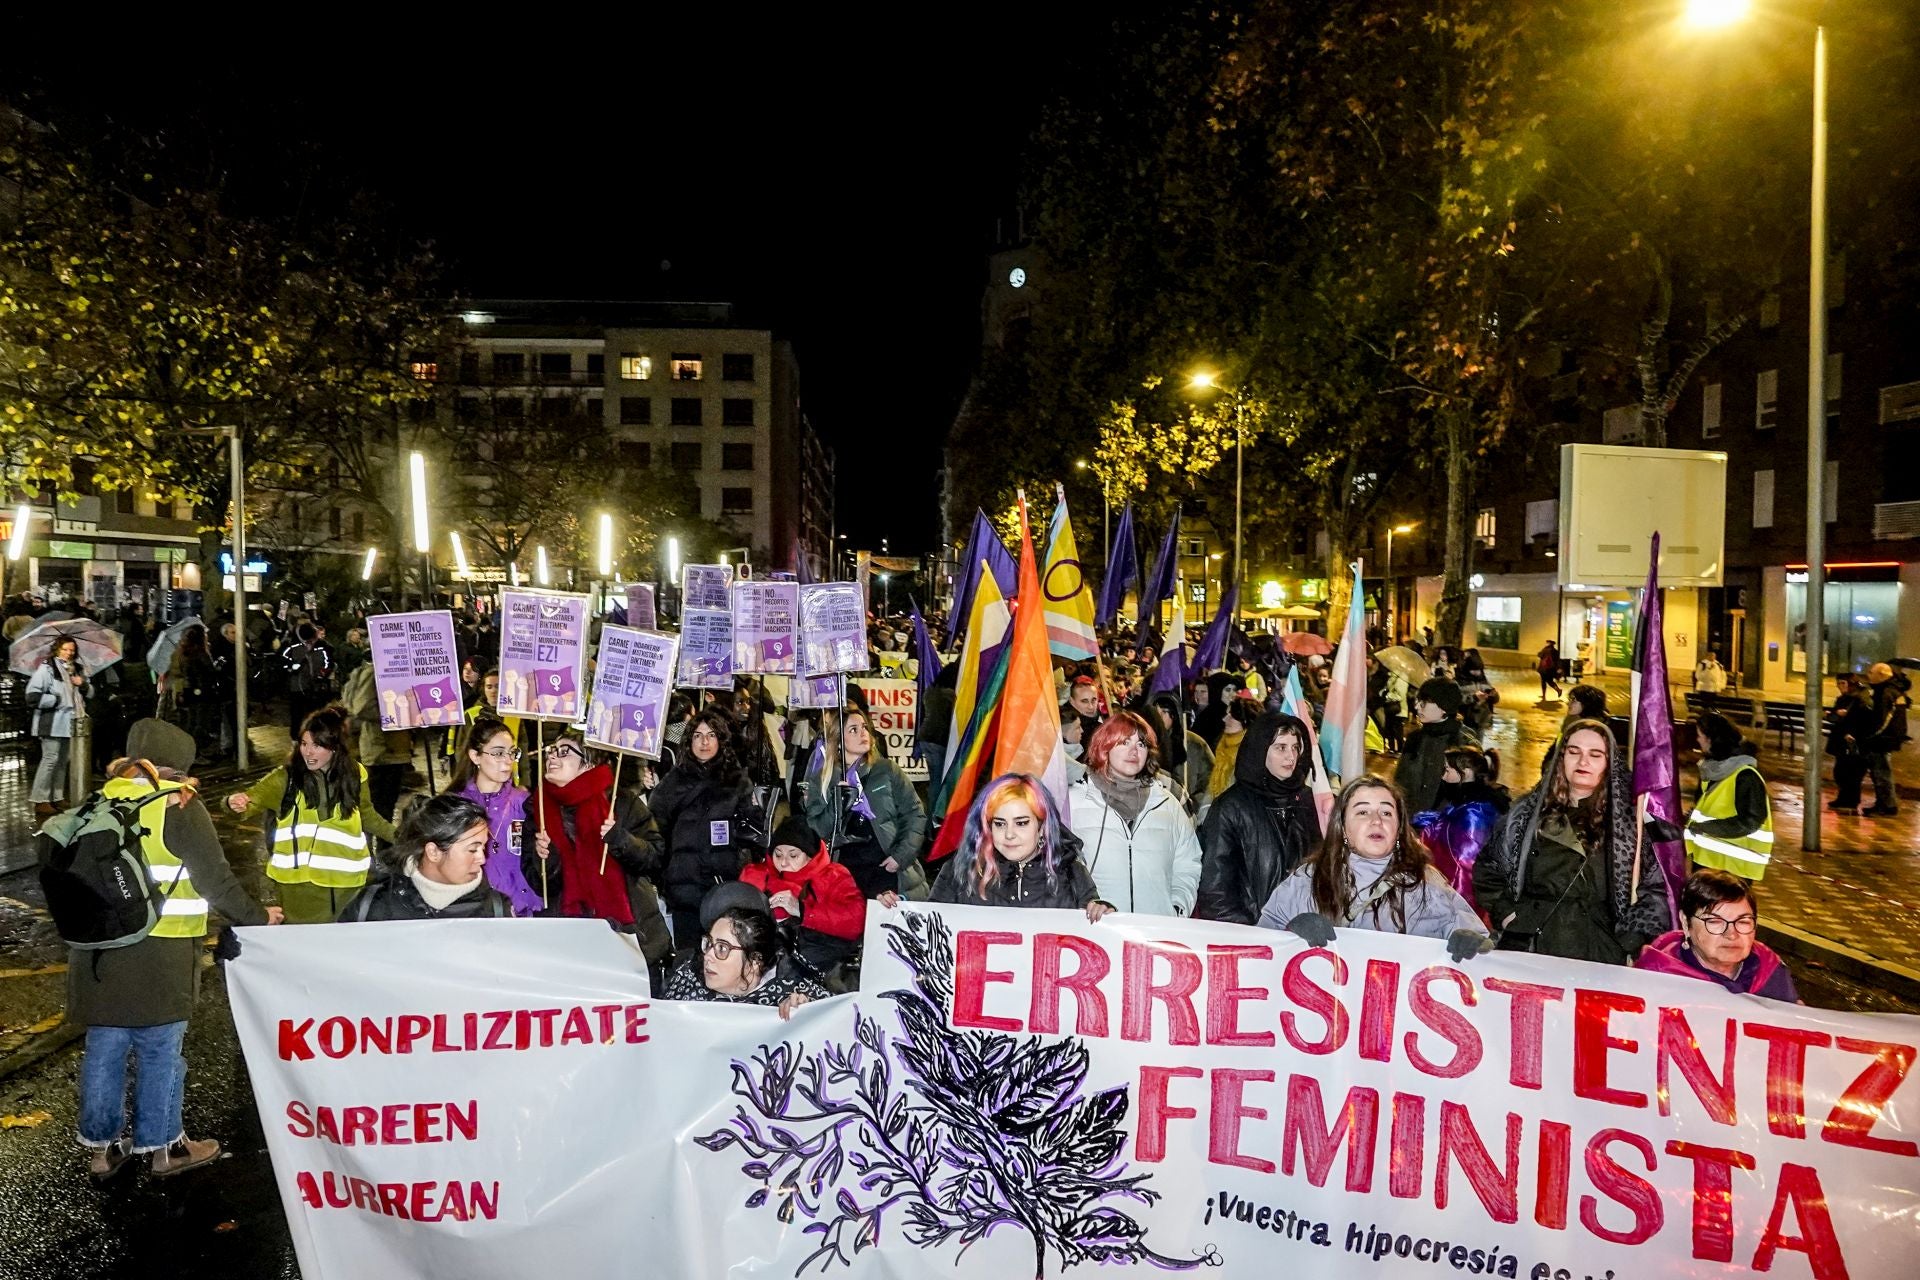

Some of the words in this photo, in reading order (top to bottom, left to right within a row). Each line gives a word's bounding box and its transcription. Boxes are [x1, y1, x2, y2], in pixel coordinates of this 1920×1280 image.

[765, 589, 775, 598] NO
[513, 603, 536, 614] CARME
[540, 620, 568, 630] BIKTIMEN
[831, 616, 860, 624] VIOLENCIA
[380, 622, 404, 632] CARME
[408, 621, 422, 633] NO
[832, 624, 860, 632] MACHISTA
[410, 632, 442, 642] RECORTES
[609, 636, 630, 648] CARME
[538, 644, 558, 663] EZ!
[413, 656, 450, 666] VIOLENCIA
[630, 656, 656, 668] BIKTIMEN
[414, 666, 451, 676] MACHISTA
[625, 679, 646, 698] EZ!
[883, 734, 915, 748] OZ
[113, 866, 132, 900] FORCLAZ
[277, 1003, 651, 1061] KONPLIZITATE
[285, 1100, 478, 1146] SAREEN
[1135, 1065, 1849, 1280] FEMINISTA
[296, 1170, 500, 1223] AURREAN
[1204, 1191, 1332, 1247] ¡Vuestra
[1345, 1222, 1518, 1280] hipocresía
